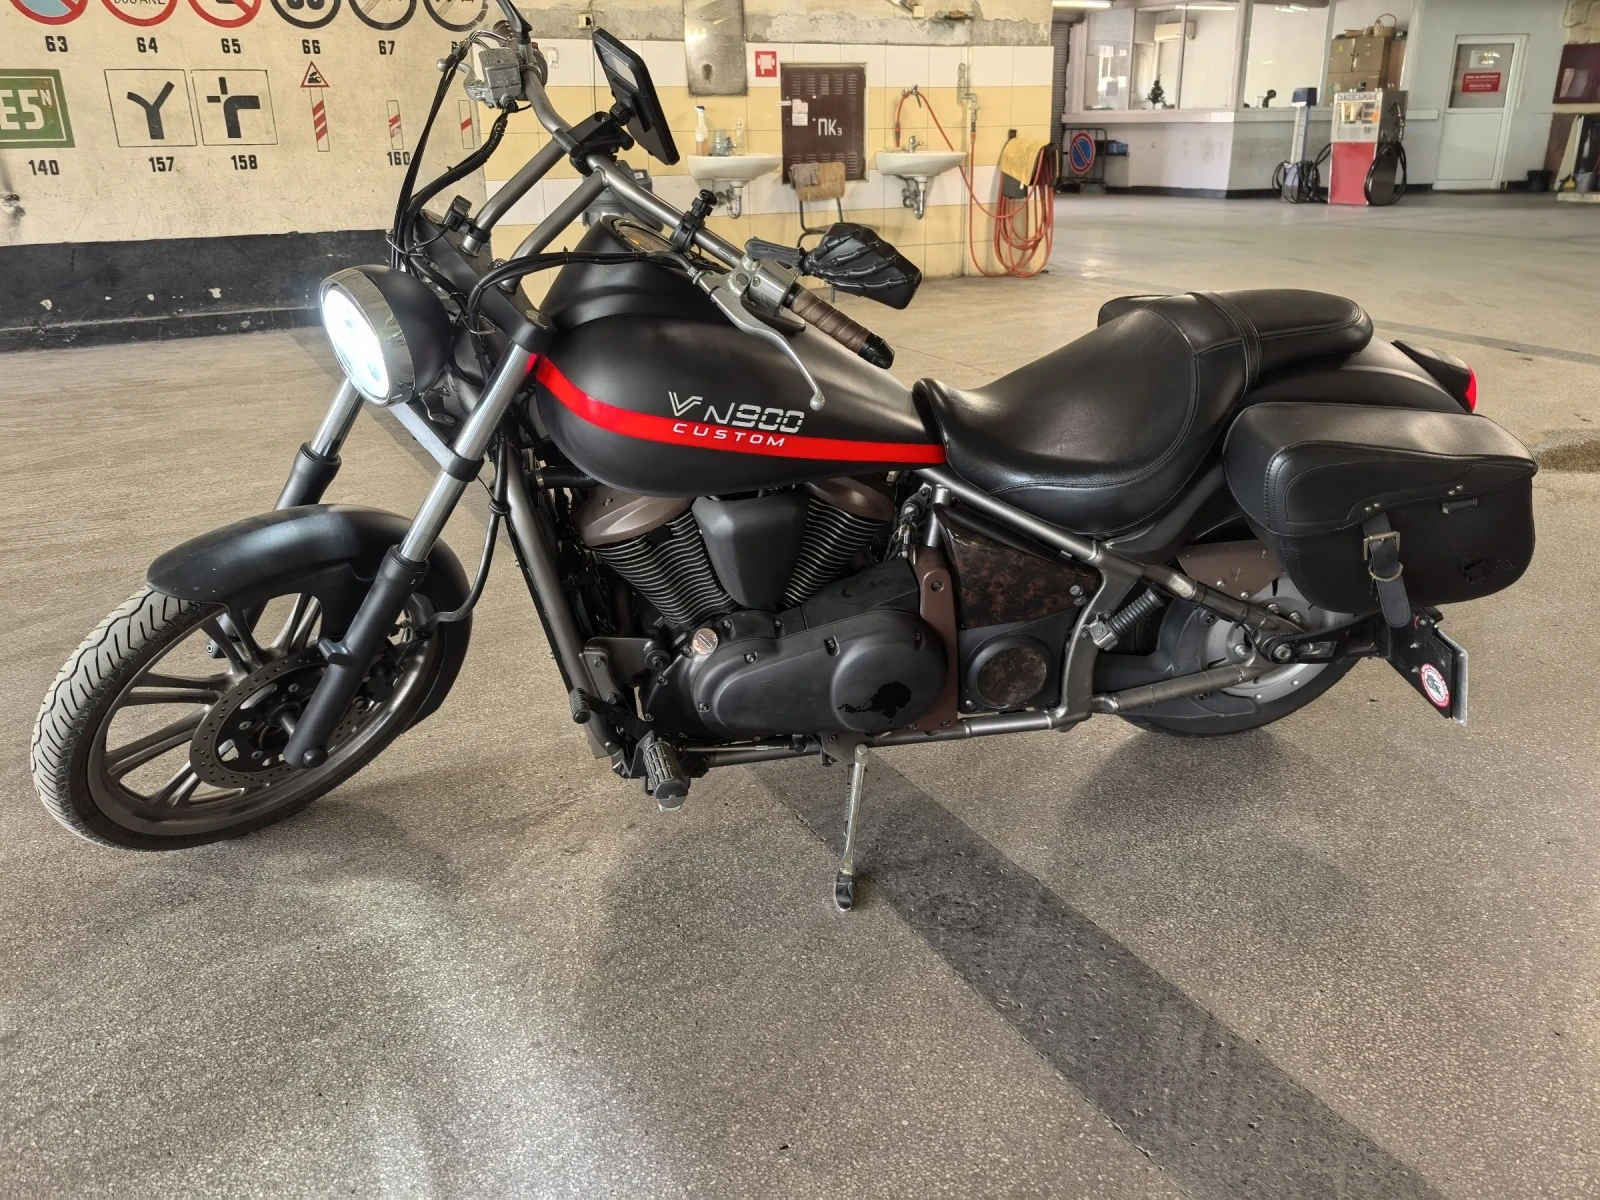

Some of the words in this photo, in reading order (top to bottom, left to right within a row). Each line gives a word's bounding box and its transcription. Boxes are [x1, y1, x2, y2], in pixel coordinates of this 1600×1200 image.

[45, 36, 68, 52] 63
[136, 37, 158, 53] 64
[221, 38, 242, 54] 65
[302, 39, 321, 54] 66
[378, 40, 396, 55] 67
[149, 156, 175, 172] 157
[231, 154, 258, 170] 158
[387, 151, 411, 166] 160
[28, 159, 60, 176] 140
[672, 422, 786, 447] CUSTOM
